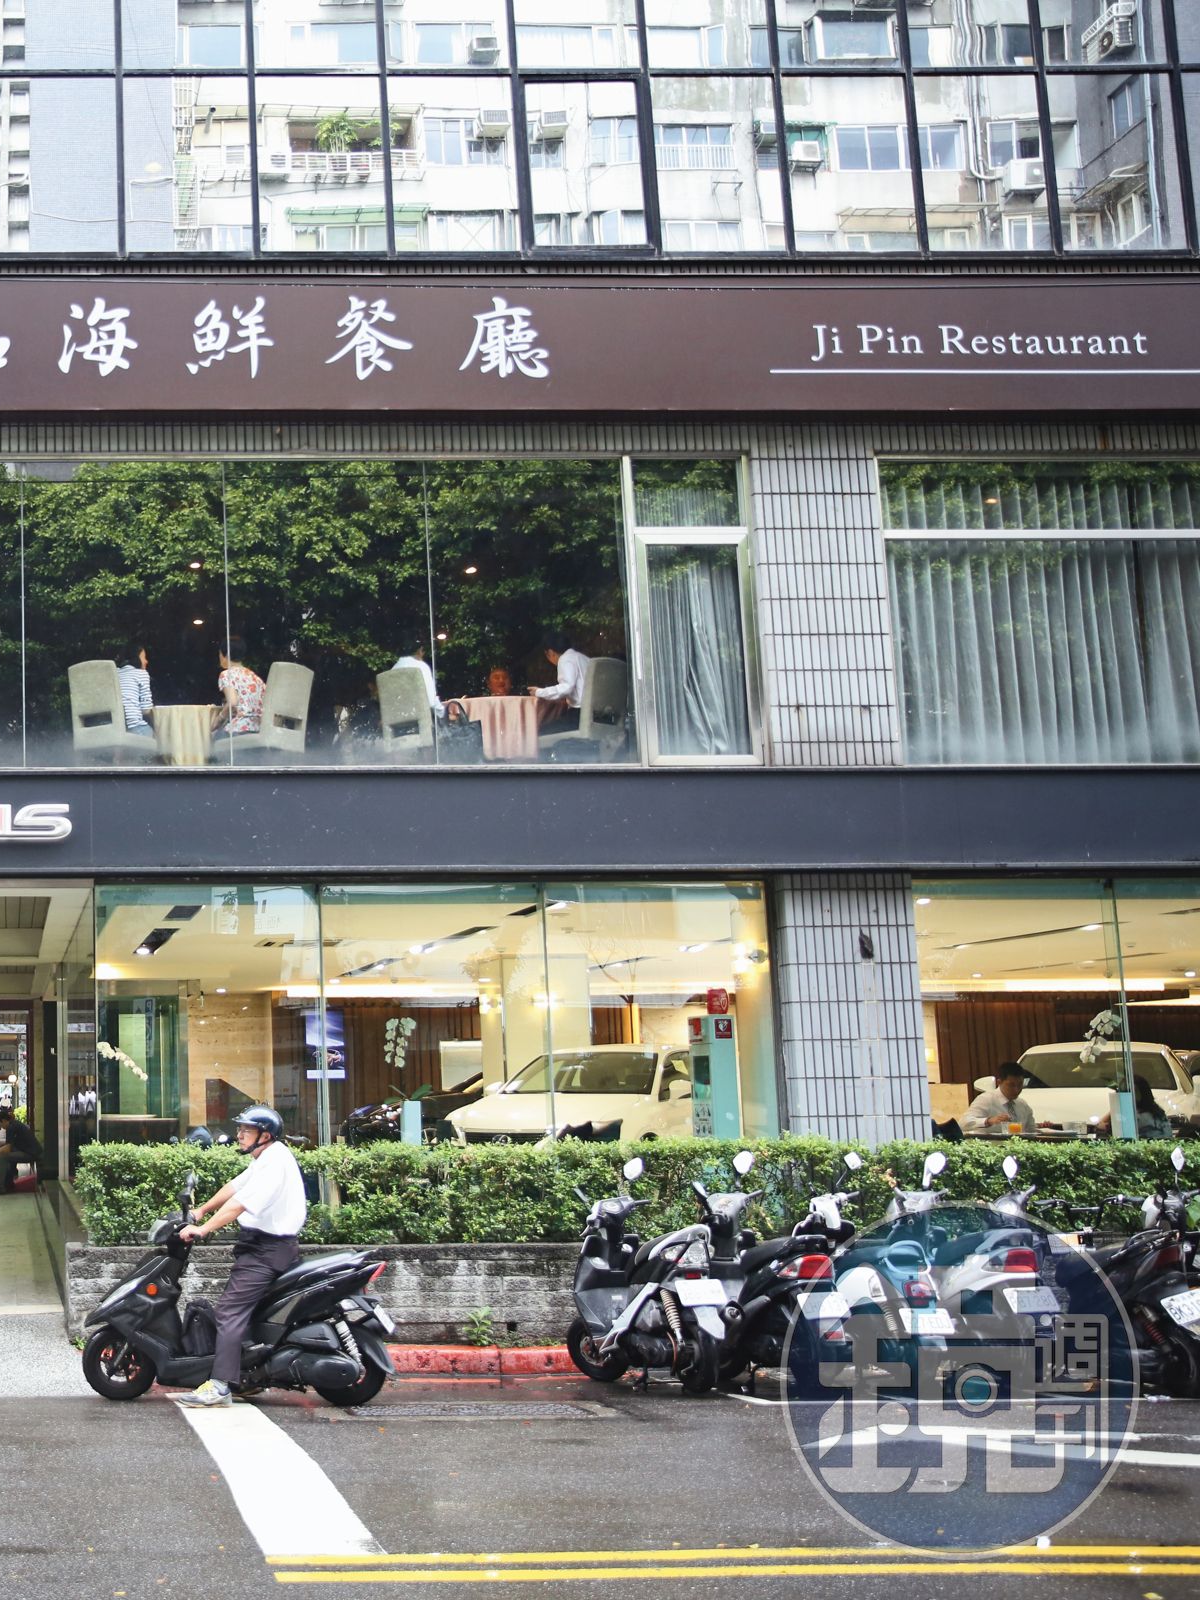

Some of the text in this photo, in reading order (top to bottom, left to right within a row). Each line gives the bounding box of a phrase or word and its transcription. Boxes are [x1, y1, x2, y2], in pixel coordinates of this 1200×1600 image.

[811, 324, 1148, 361] Ji Pin Restaurant
